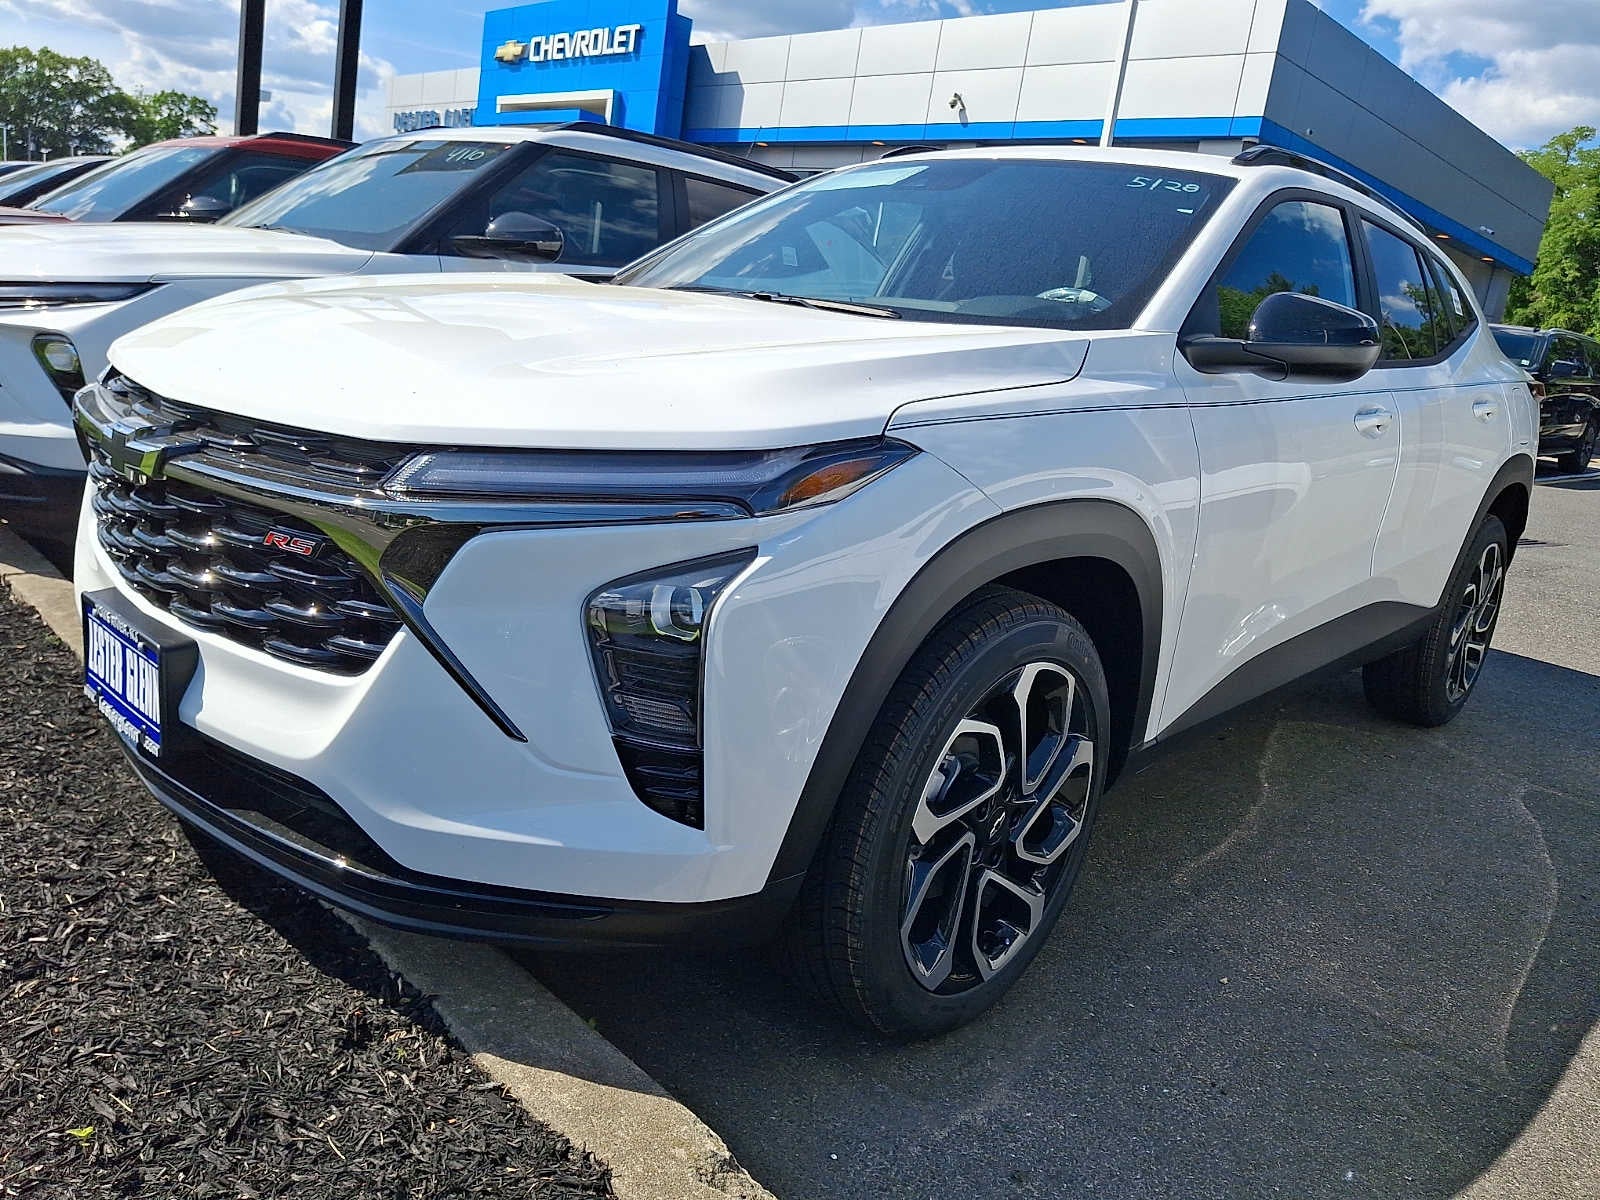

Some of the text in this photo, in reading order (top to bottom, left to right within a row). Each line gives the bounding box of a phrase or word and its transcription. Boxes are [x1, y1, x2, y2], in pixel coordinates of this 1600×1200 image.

[529, 23, 641, 62] CHEVROLET
[263, 531, 316, 556] RS
[88, 617, 161, 725] LESTER GLENN
